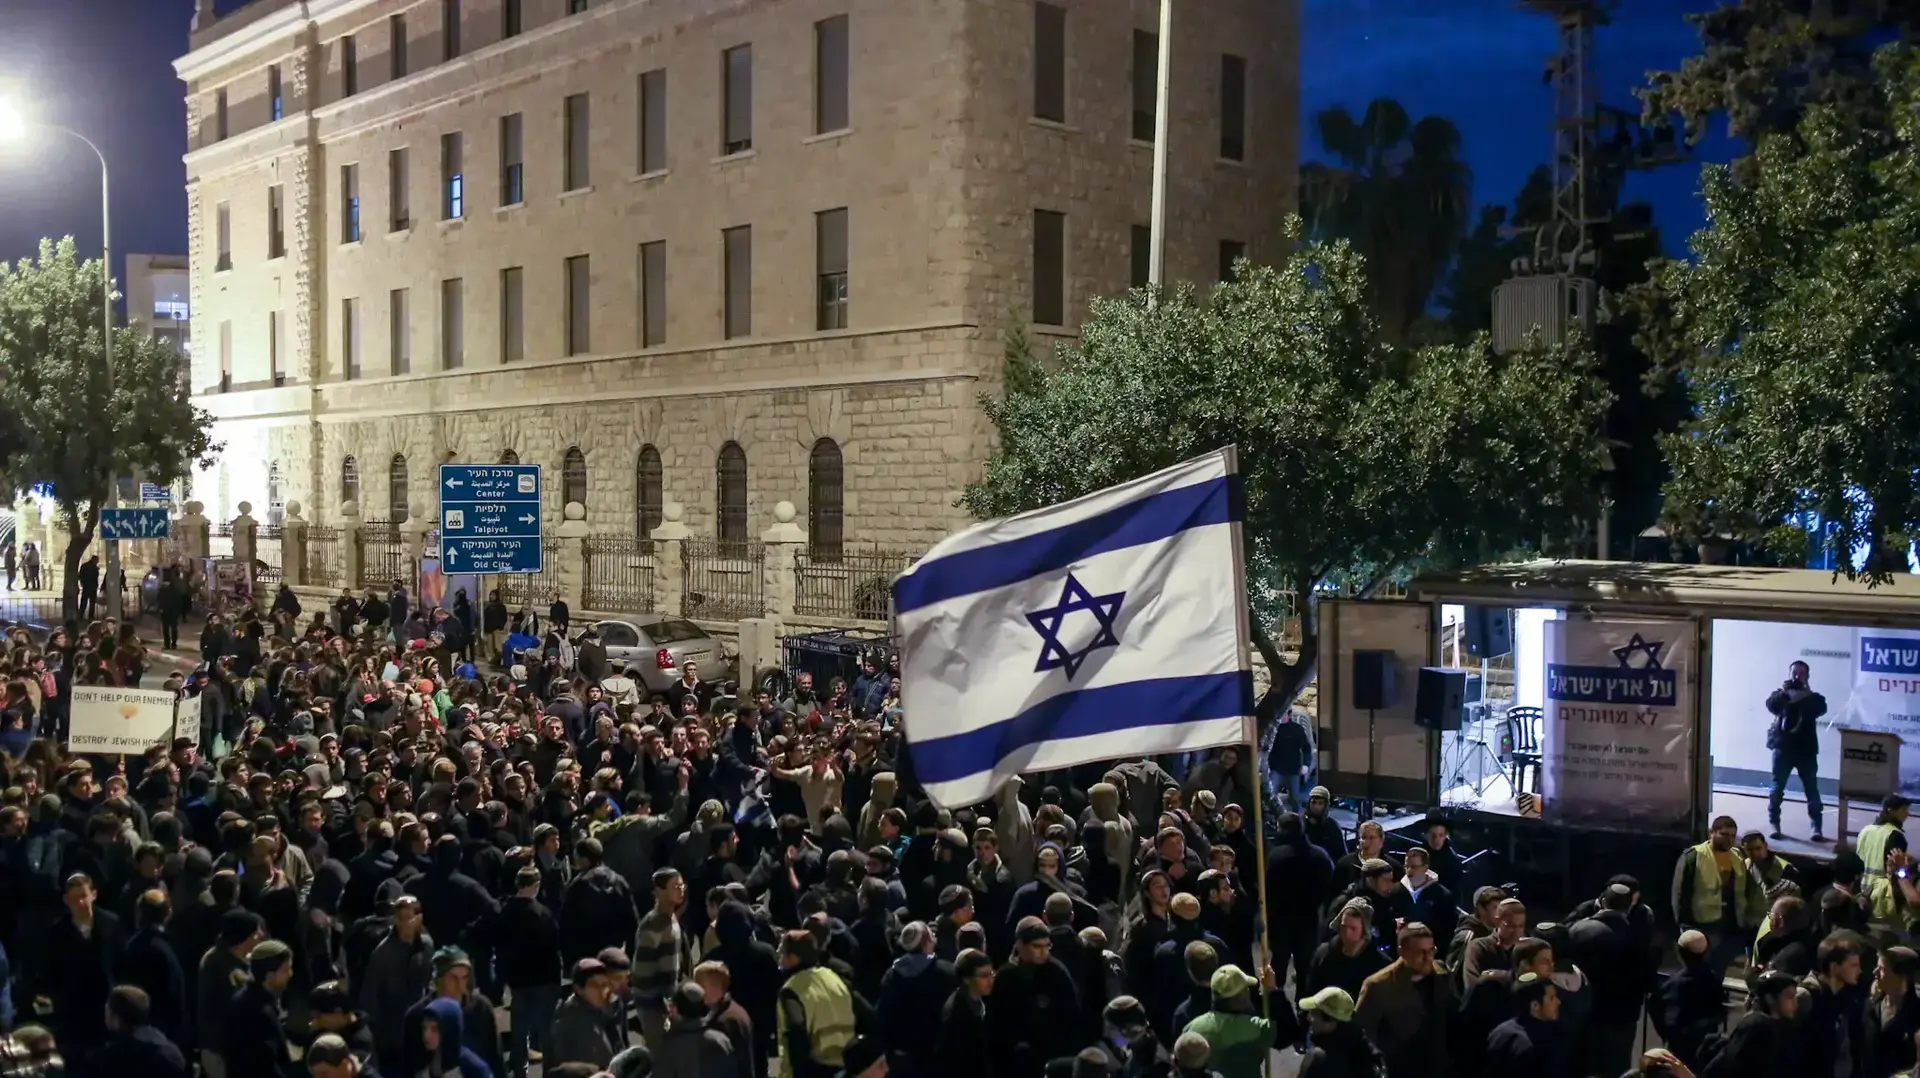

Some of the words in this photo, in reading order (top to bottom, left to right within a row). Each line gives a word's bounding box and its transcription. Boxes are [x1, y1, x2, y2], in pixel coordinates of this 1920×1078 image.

[467, 469, 488, 477] העיר
[492, 469, 514, 477] מרכז
[474, 504, 507, 513] תלפיות
[474, 526, 508, 534] Talpiyot
[462, 541, 497, 550] העתיקה
[492, 561, 511, 569] City
[1865, 642, 1919, 667] שראל
[1550, 668, 1601, 695] ישראל
[1605, 676, 1644, 700] ארץ
[1649, 674, 1673, 698] על
[1879, 678, 1920, 694] תרים
[74, 692, 98, 700] DON'T
[100, 693, 122, 702] HELP
[124, 695, 142, 703] OUR
[142, 696, 174, 706] ENEMIES
[1558, 706, 1629, 726] מוותרים
[1634, 707, 1659, 726] לא
[72, 735, 108, 745] DESTROY
[111, 737, 141, 746] JEWISH
